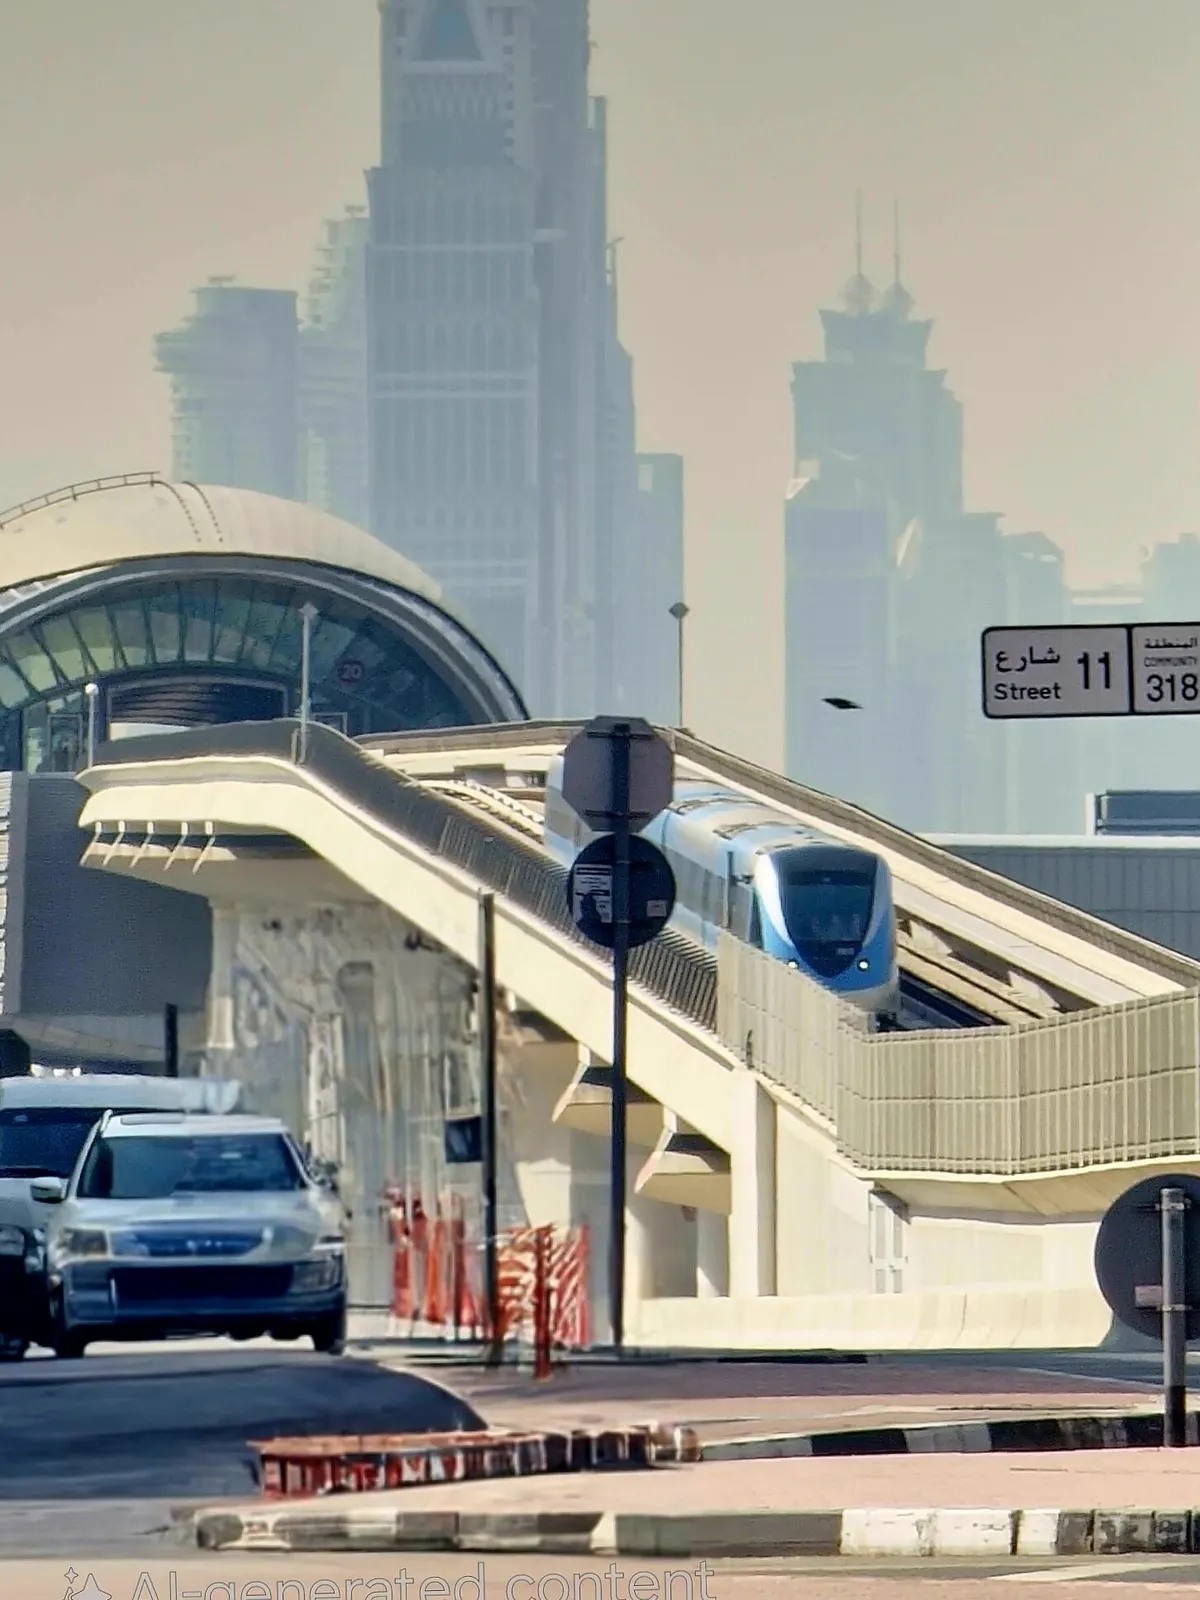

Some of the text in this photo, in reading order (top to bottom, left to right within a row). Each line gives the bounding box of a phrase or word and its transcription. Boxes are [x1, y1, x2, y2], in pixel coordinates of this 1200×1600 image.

[996, 647, 1060, 672] شارع
[1078, 652, 1110, 689] 11
[994, 683, 1061, 700] Street
[1147, 674, 1198, 702] 318
